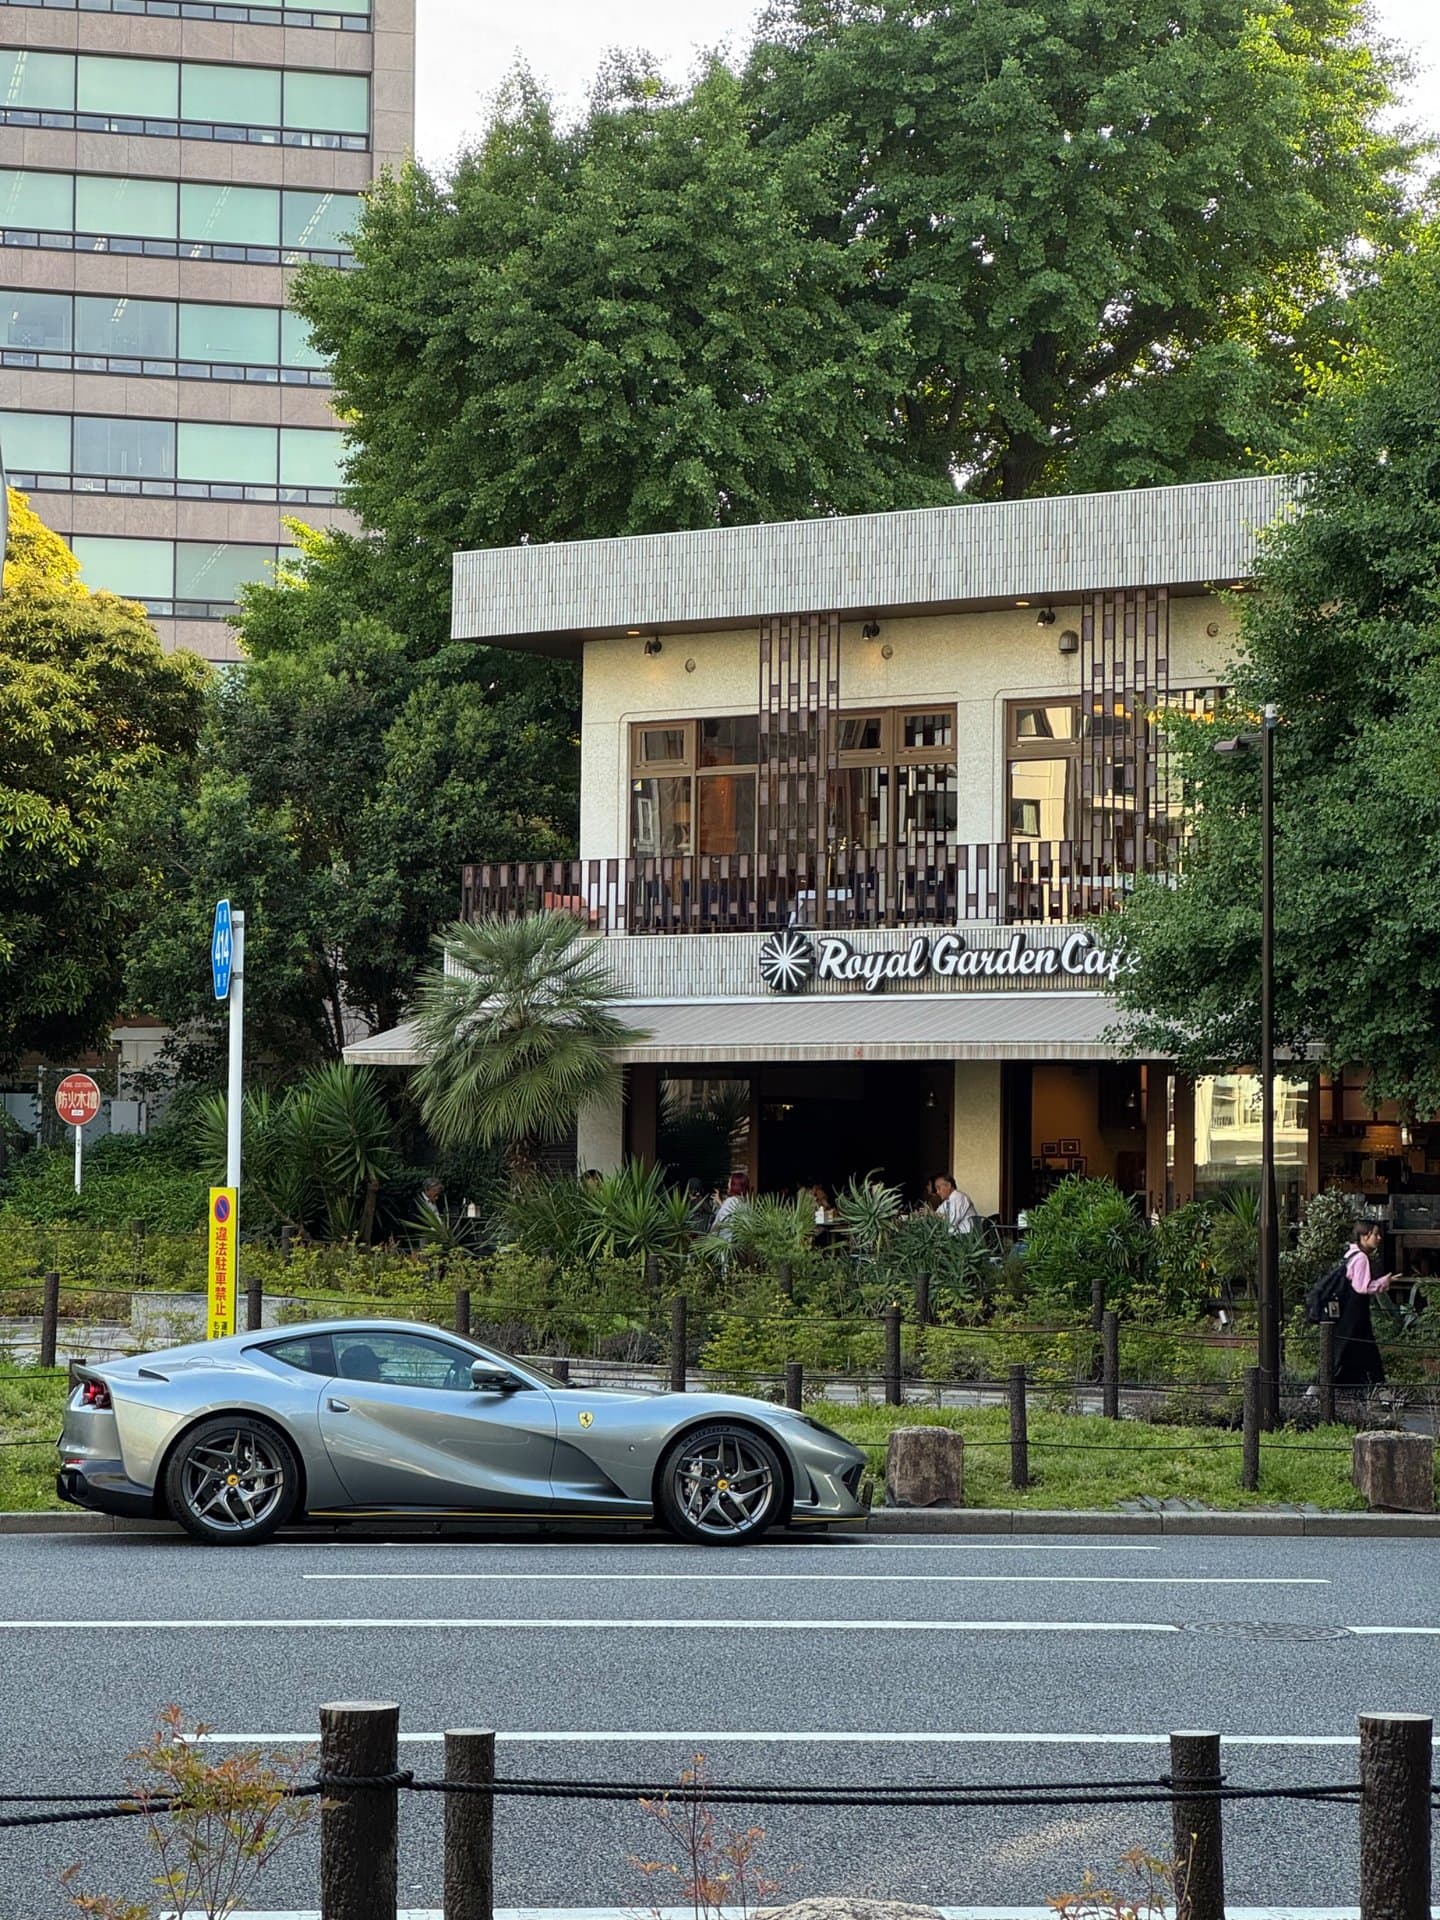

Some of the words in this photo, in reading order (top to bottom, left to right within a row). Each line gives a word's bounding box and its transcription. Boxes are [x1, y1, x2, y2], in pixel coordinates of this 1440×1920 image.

[215, 928, 229, 967] 414
[818, 937, 926, 992] Royal
[931, 933, 1059, 976] Garden
[215, 1227, 227, 1316] 違法駐車禁止
